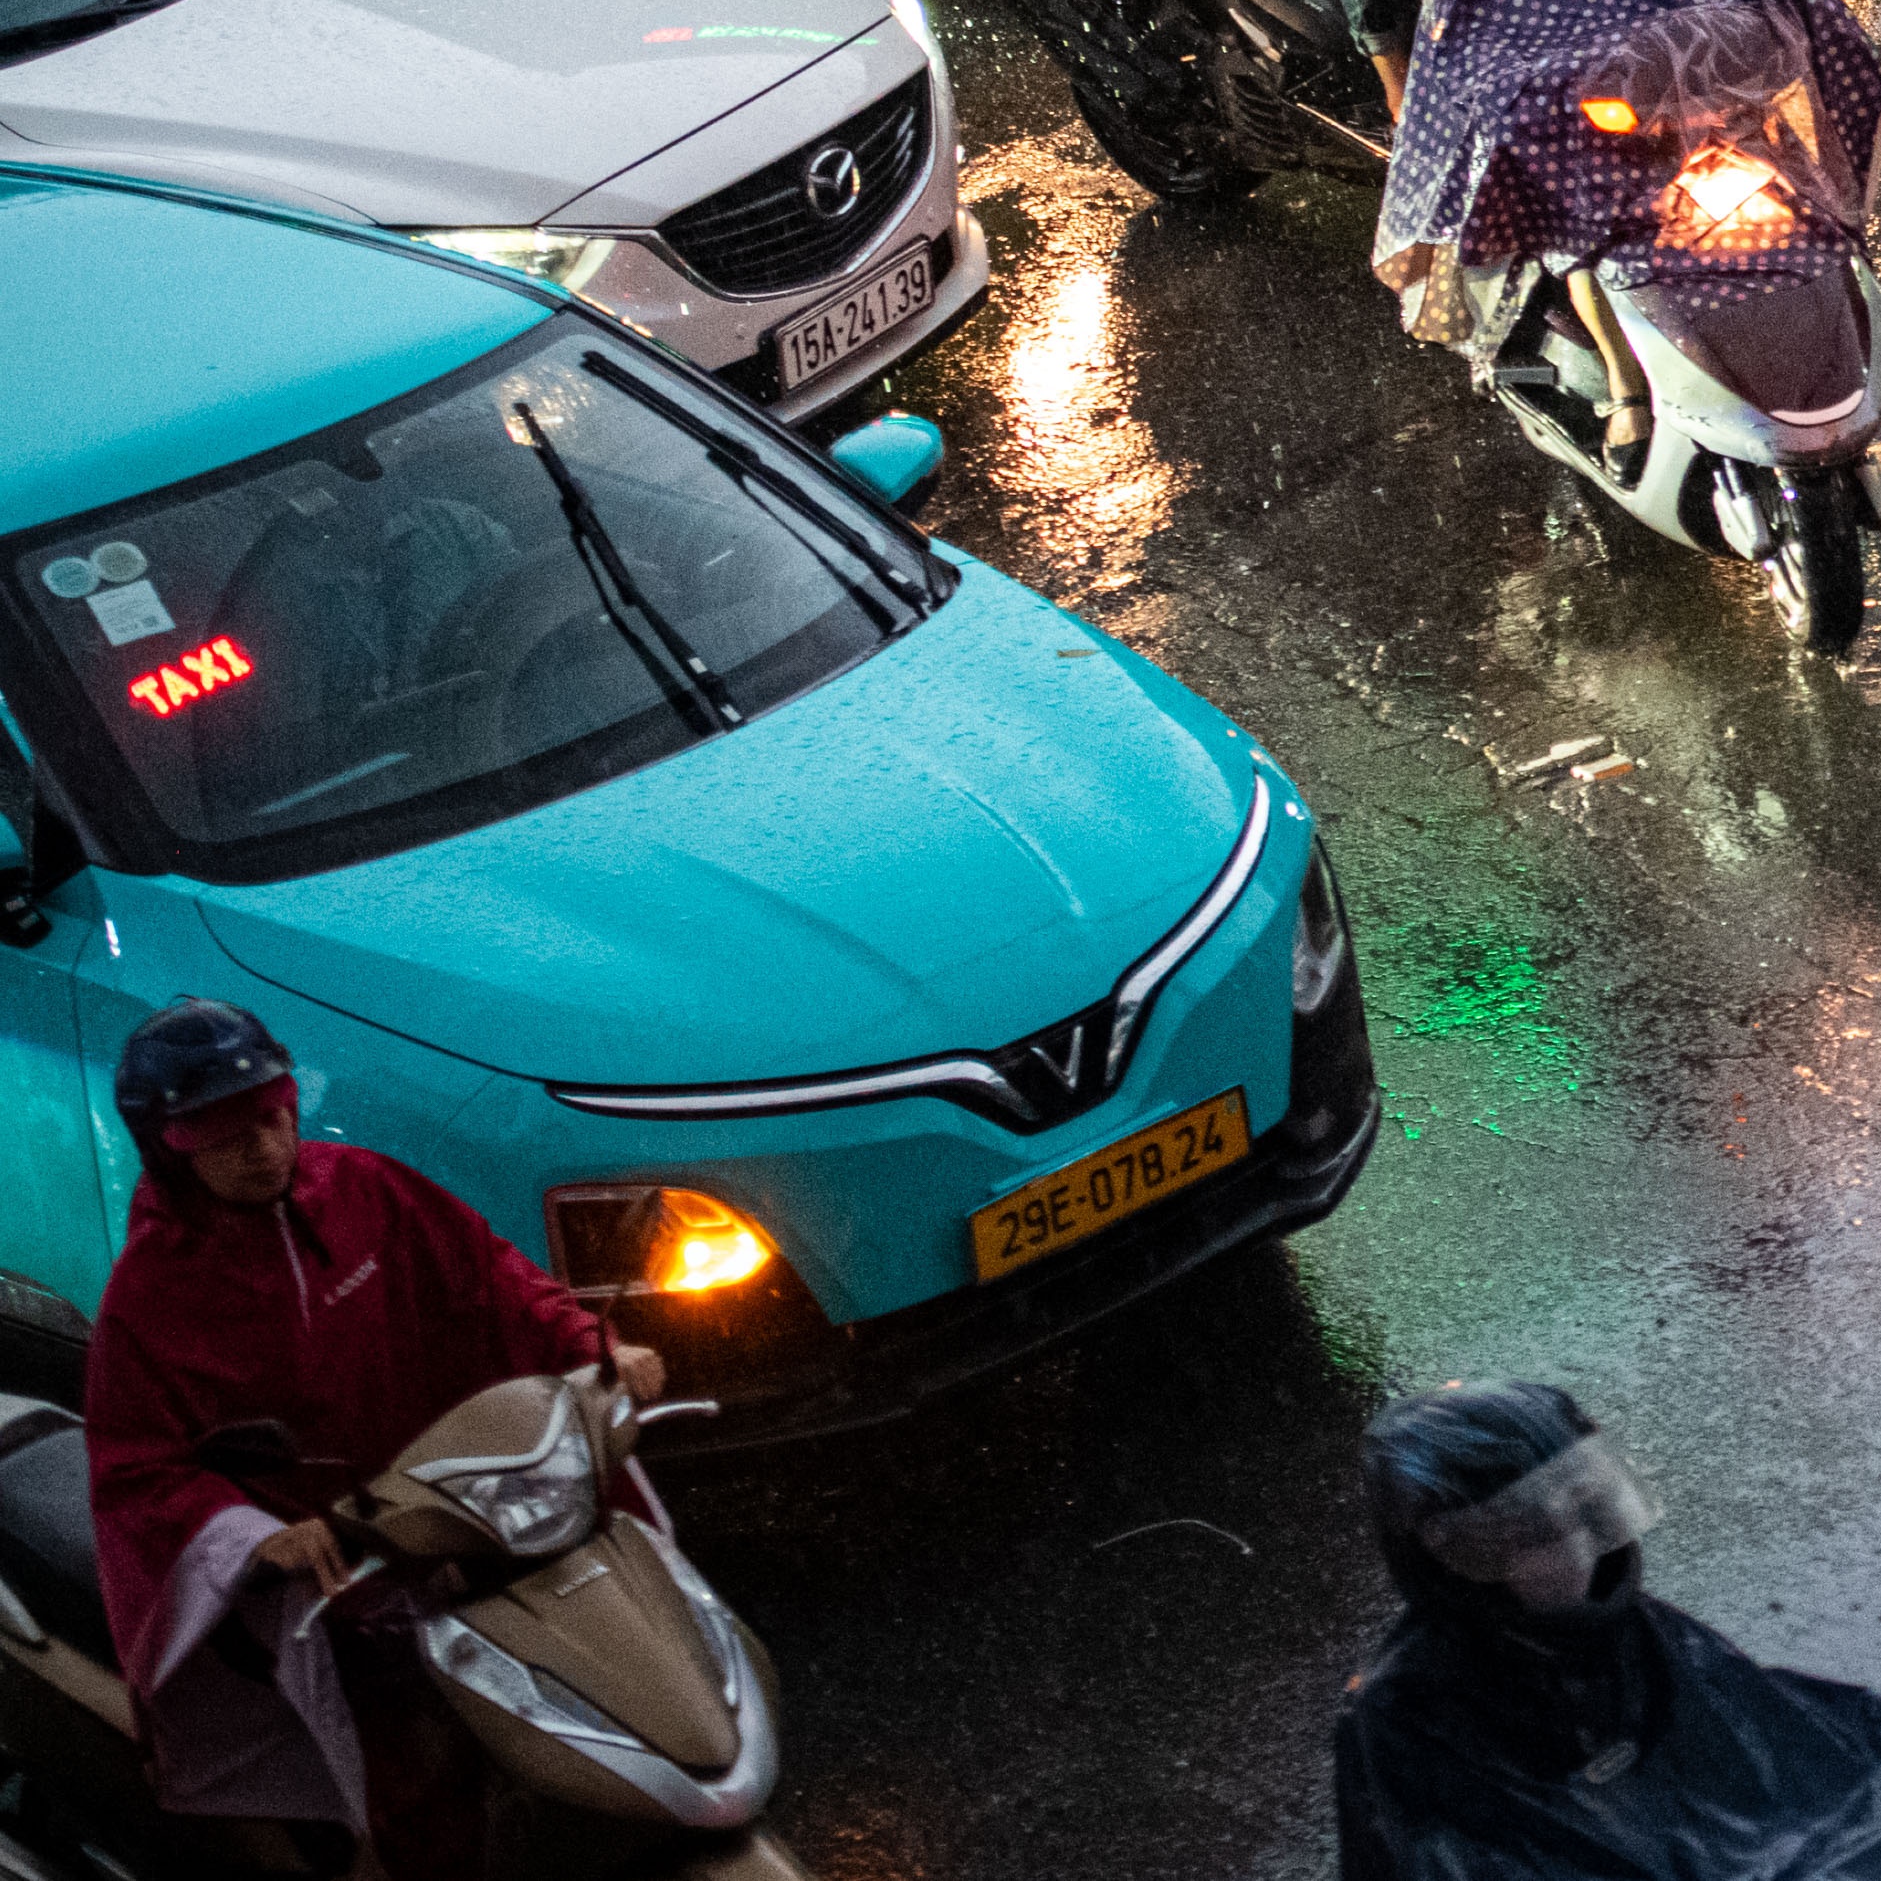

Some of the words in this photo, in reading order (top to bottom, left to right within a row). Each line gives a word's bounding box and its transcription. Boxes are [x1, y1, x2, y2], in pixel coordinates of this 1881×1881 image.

[790, 259, 927, 378] 15A-241.39
[129, 636, 253, 717] TAXI
[996, 1111, 1225, 1260] 29E-078.24
